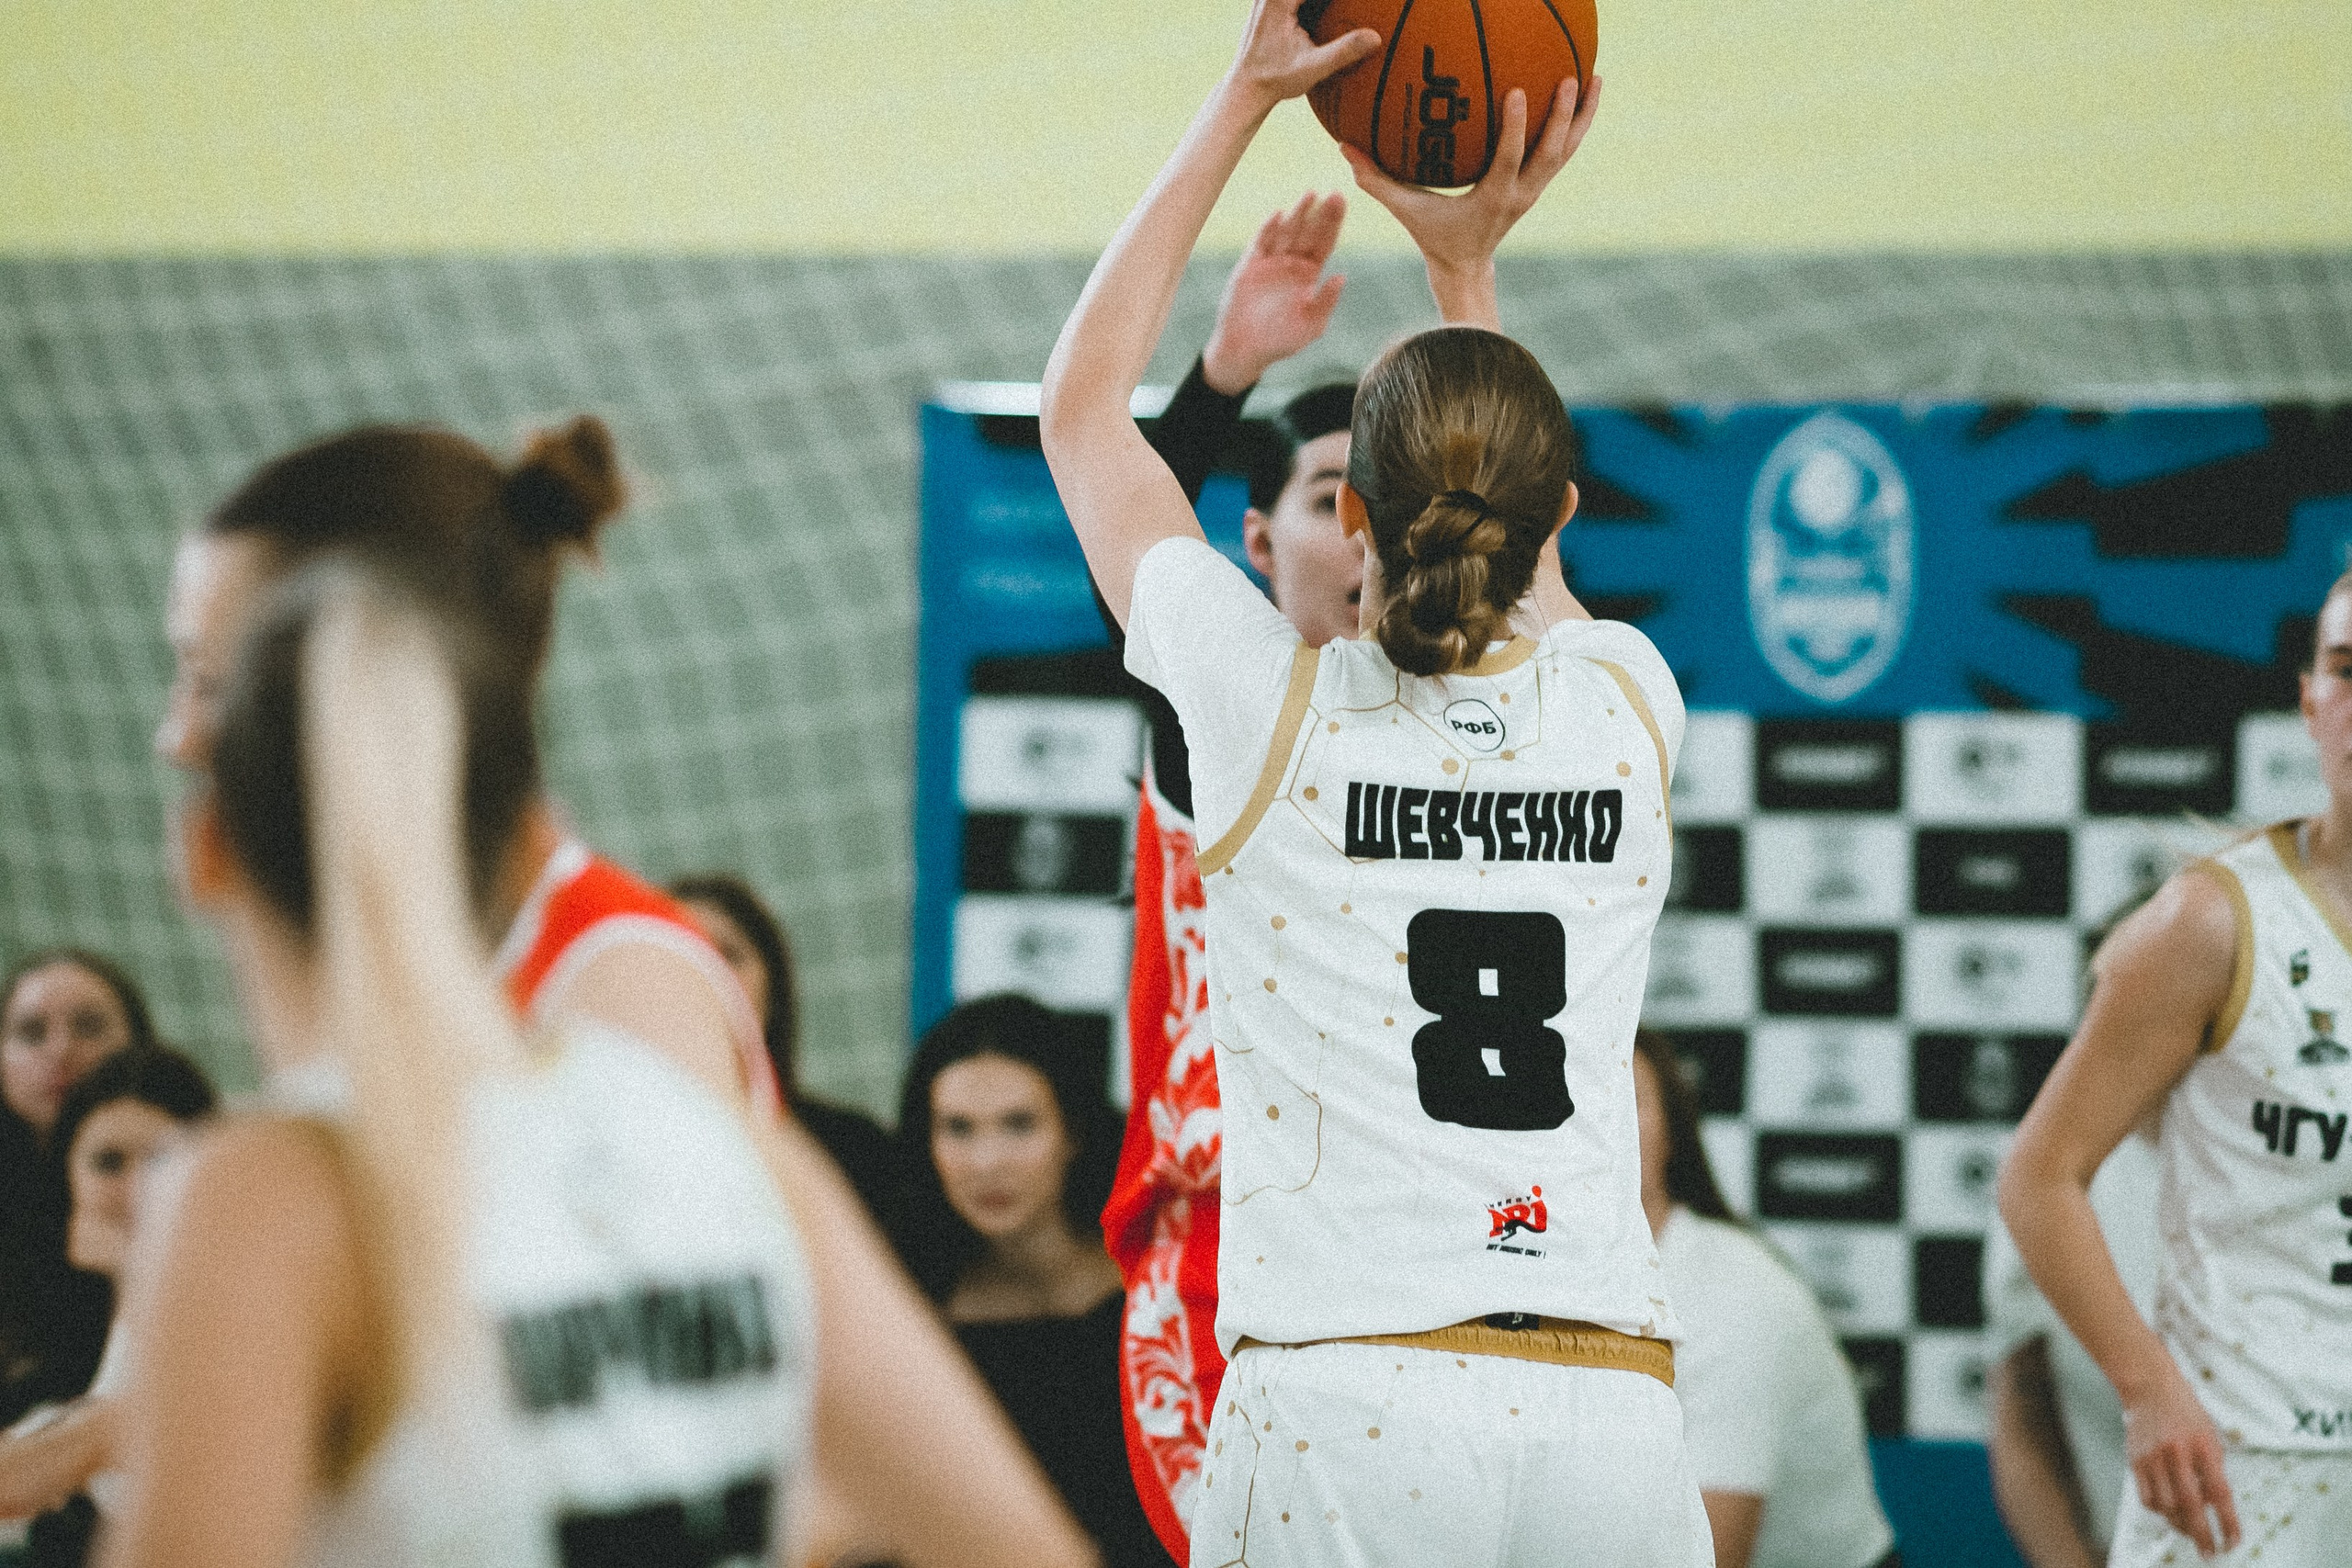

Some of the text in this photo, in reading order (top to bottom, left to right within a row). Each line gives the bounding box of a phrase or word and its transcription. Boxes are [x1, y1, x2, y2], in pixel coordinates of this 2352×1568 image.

[1451, 719, 1497, 736] РФБ
[1345, 781, 1623, 863] ШЕВЧЕНКО
[1407, 908, 1575, 1132] 8
[2253, 1100, 2352, 1162] ЧГУ
[2296, 1407, 2352, 1438] ХИ
